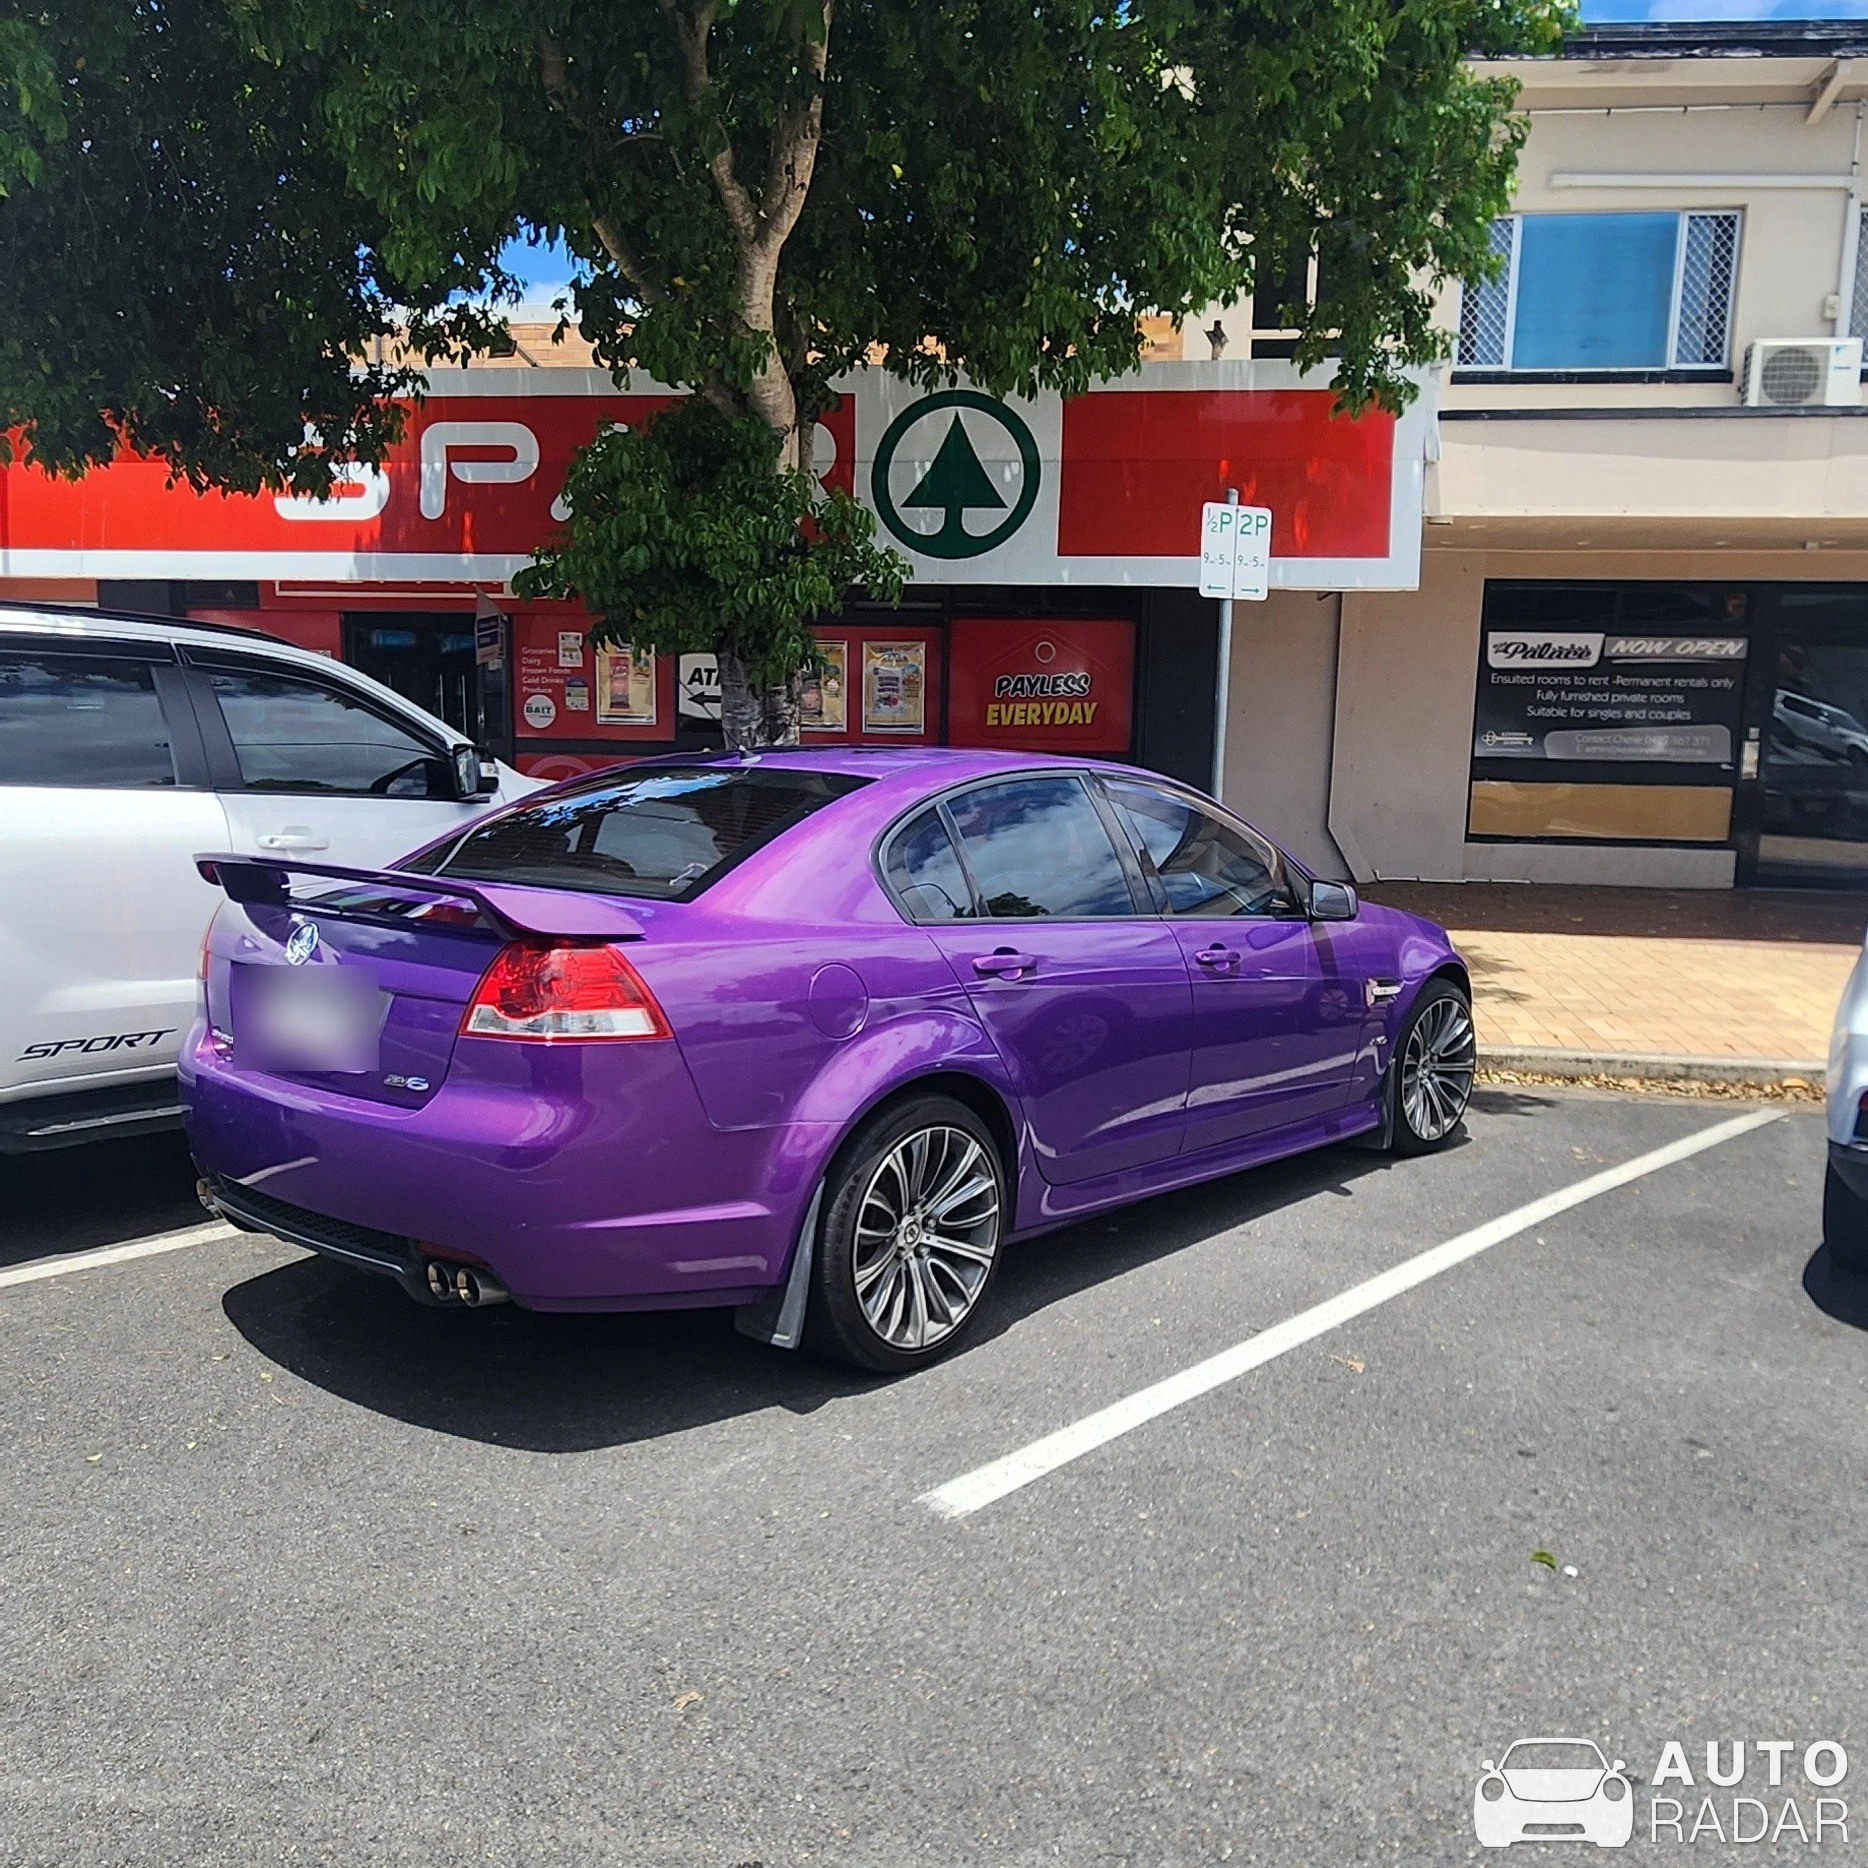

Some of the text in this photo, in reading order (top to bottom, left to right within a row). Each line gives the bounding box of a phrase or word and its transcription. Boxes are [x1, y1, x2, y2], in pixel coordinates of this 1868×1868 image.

[1239, 514, 1268, 536] 2P
[521, 646, 556, 655] Groceries
[1505, 641, 1592, 660] Palace
[1611, 640, 1744, 655] NOW OPEN
[522, 657, 541, 666] Dairy
[522, 667, 572, 675] Frozen Foods
[687, 667, 719, 686] AT
[522, 676, 564, 684] Cold Drinks
[995, 672, 1091, 698] PAYLESS
[1490, 673, 1535, 685] Ensuited
[1537, 675, 1571, 685] rooms
[1573, 675, 1587, 686] to
[1588, 676, 1610, 686] rent
[1674, 677, 1709, 688] rentals
[1711, 678, 1735, 690] only
[522, 685, 553, 694] Produce
[1536, 690, 1685, 704] Fully furnished private rooms
[526, 705, 552, 714] BAIT
[986, 702, 1098, 726] EVERYDAY
[1526, 705, 1692, 721] Suitable for singles and couples
[16, 1028, 178, 1062] SPORT
